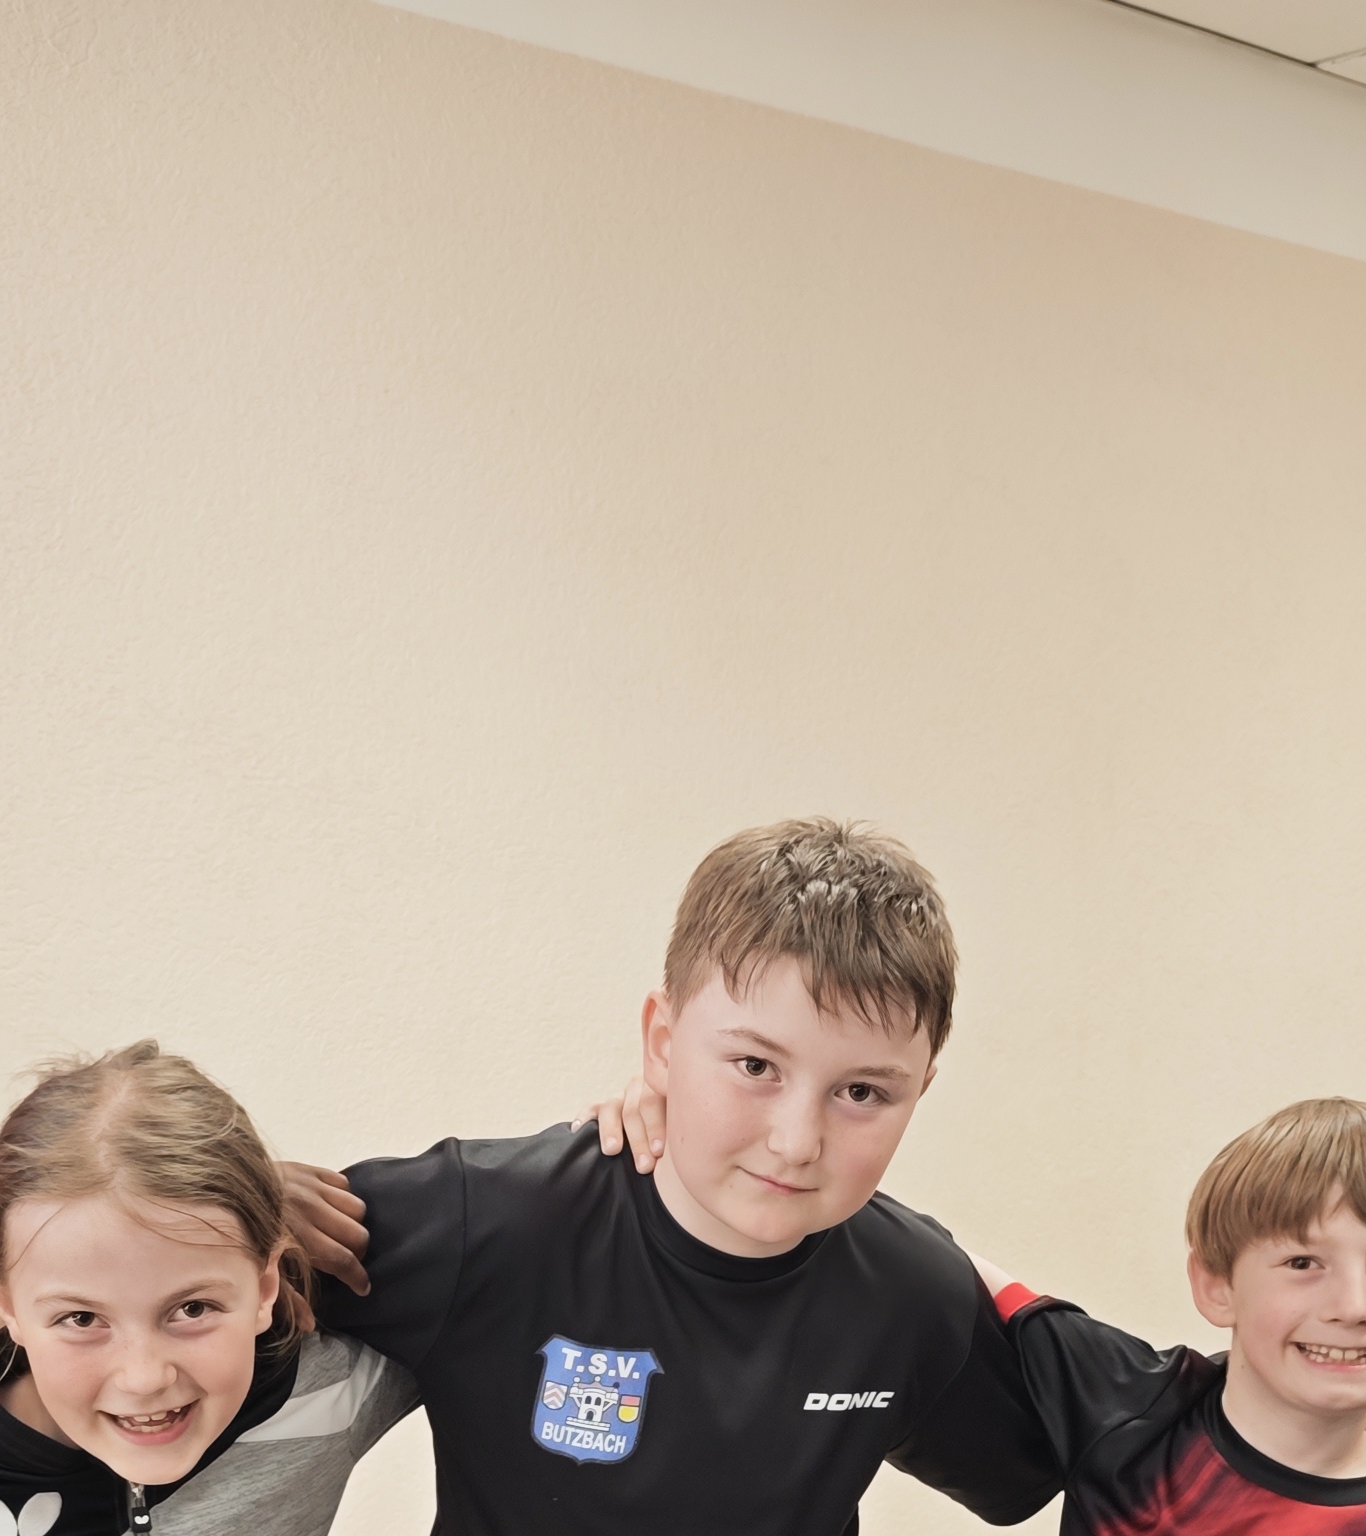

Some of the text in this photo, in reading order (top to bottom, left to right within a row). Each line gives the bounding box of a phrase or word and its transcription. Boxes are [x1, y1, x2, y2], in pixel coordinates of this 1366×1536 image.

[561, 1347, 640, 1379] T.S.V.
[803, 1391, 895, 1411] DONIC
[541, 1421, 627, 1454] BUTZBACH
